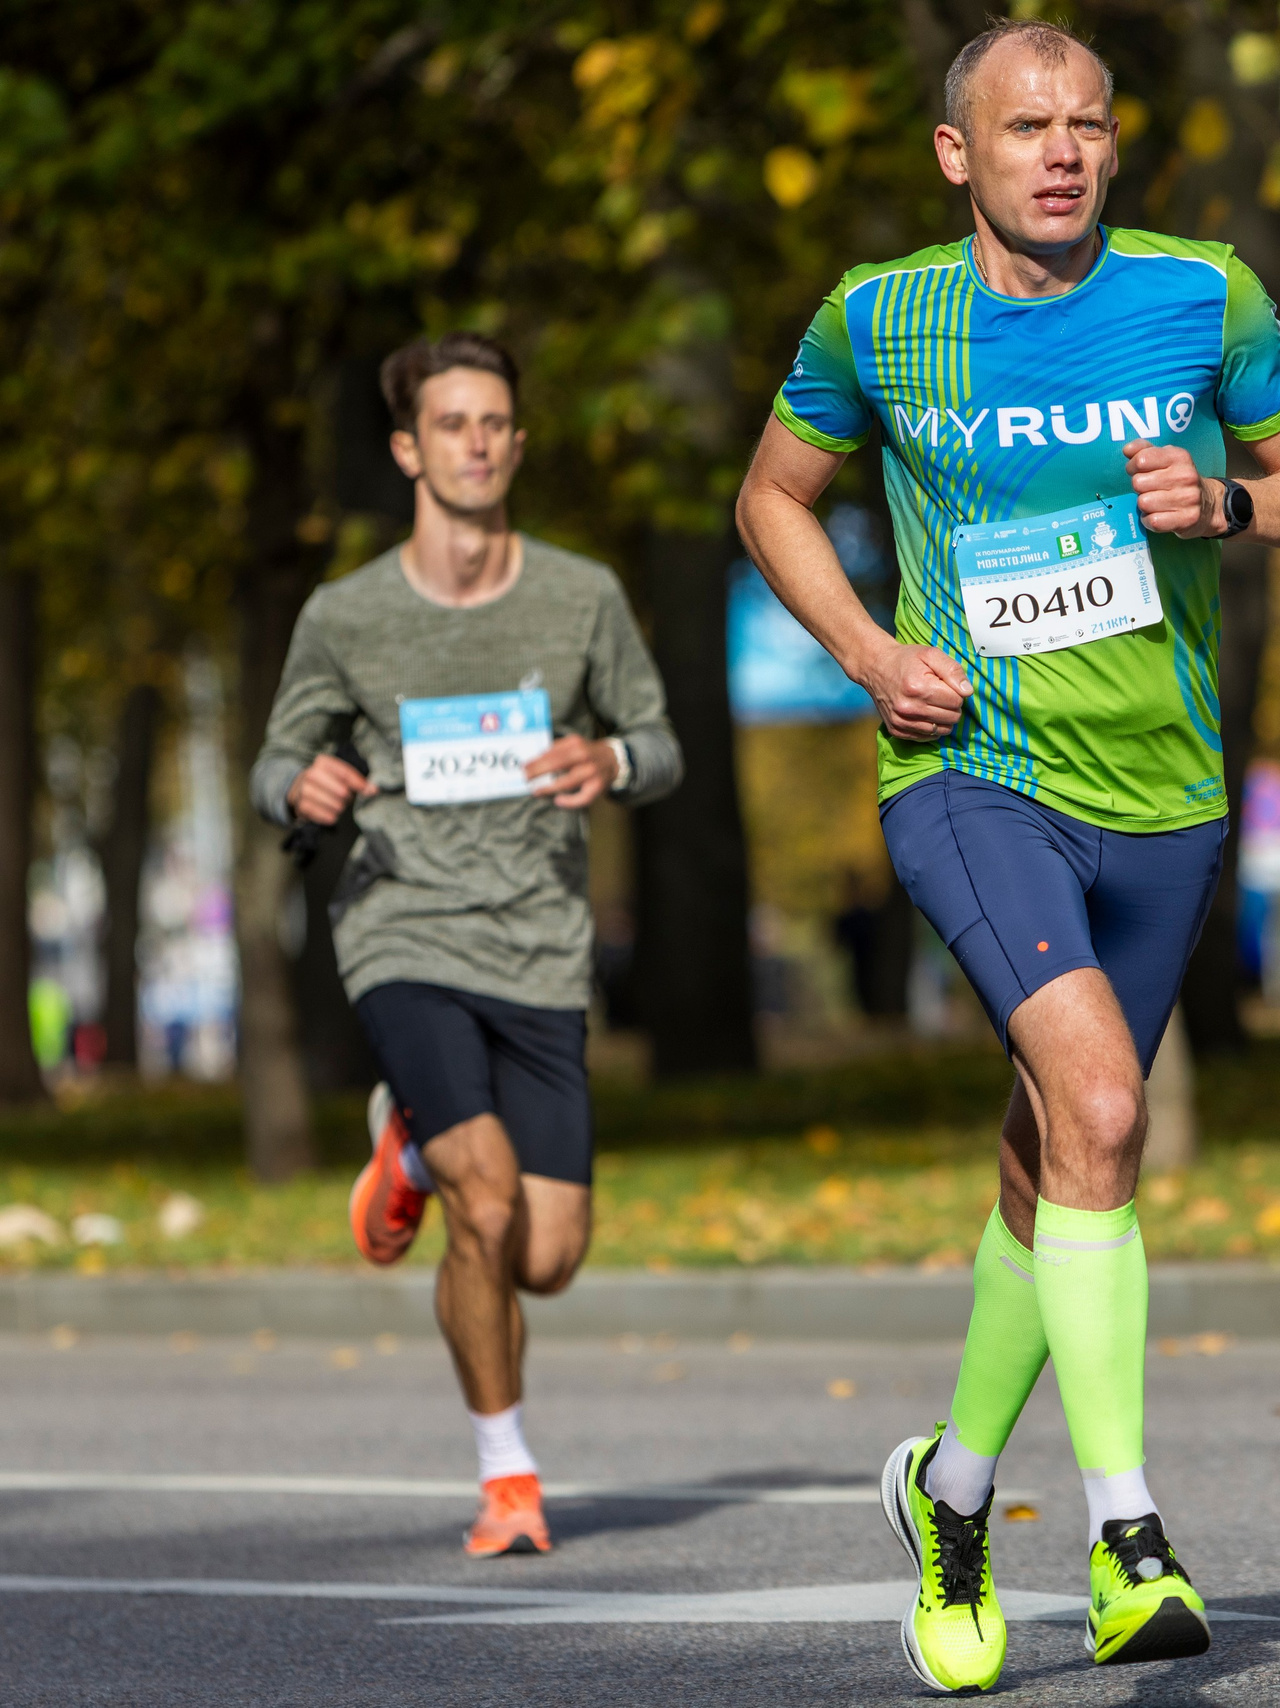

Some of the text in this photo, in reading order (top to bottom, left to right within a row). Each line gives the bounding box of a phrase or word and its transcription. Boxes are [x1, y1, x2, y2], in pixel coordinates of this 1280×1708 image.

[894, 396, 1161, 448] MYRUN
[977, 551, 1049, 569] МОЯ СТОЛИЦА
[982, 545, 1030, 556] ПОЛУМАРАФОН
[985, 576, 1113, 628] 20410
[1138, 569, 1151, 604] МОСКВА
[421, 748, 520, 780] 20296
